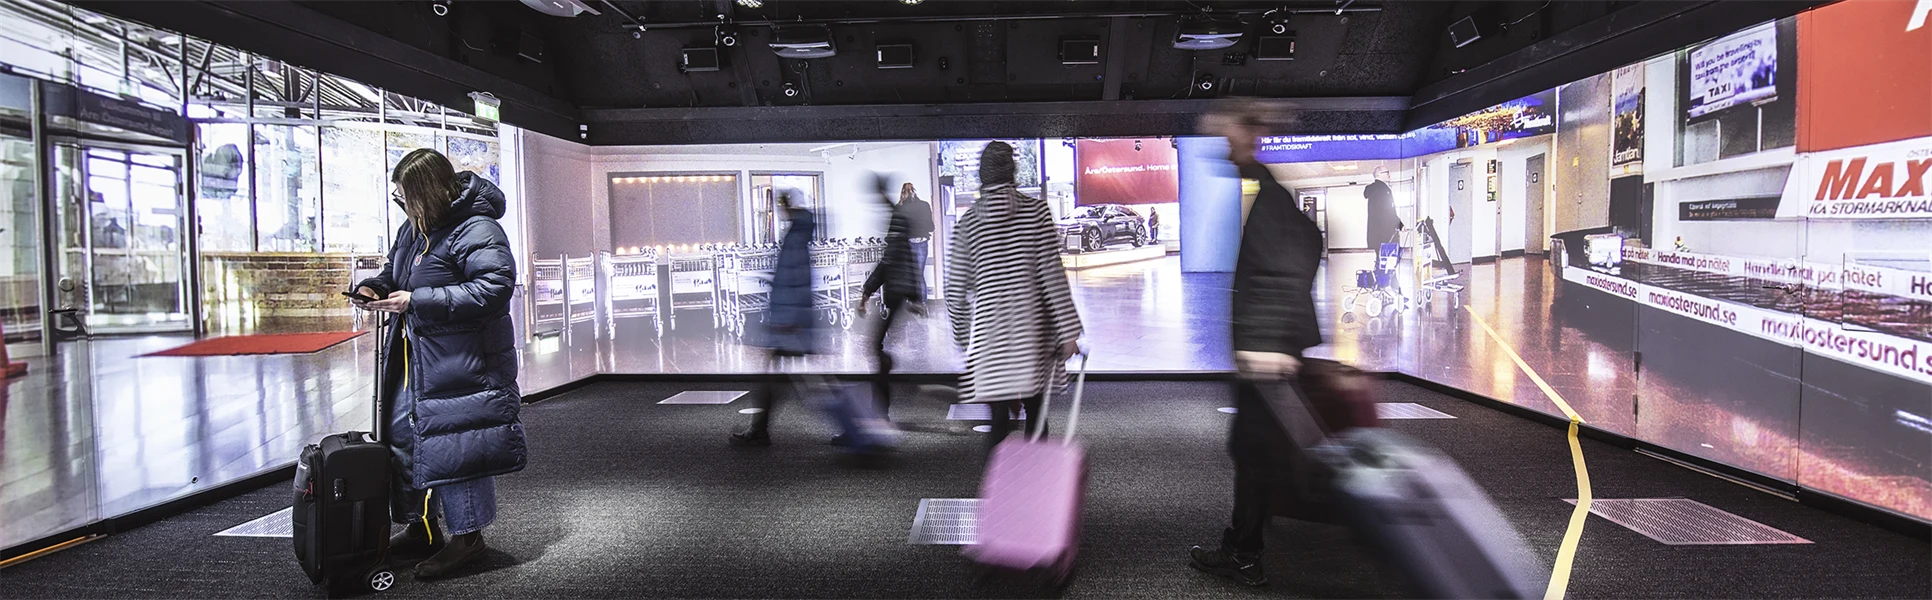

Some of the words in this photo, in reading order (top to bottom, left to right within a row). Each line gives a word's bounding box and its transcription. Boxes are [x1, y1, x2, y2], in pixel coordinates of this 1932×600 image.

[1716, 53, 1724, 61] be
[1708, 82, 1731, 98] TAXI
[1147, 163, 1170, 171] Home
[1815, 156, 1932, 201] MAX
[1809, 203, 1826, 214] ICA
[1658, 251, 1680, 264] Handla
[1681, 255, 1695, 267] mat
[1696, 256, 1707, 270] på
[1708, 257, 1730, 272] nätet
[1586, 273, 1637, 298] maxiostersund.se
[1817, 266, 1836, 285] på
[1840, 267, 1882, 288] nätet
[1649, 291, 1737, 326] maxiostersund.se
